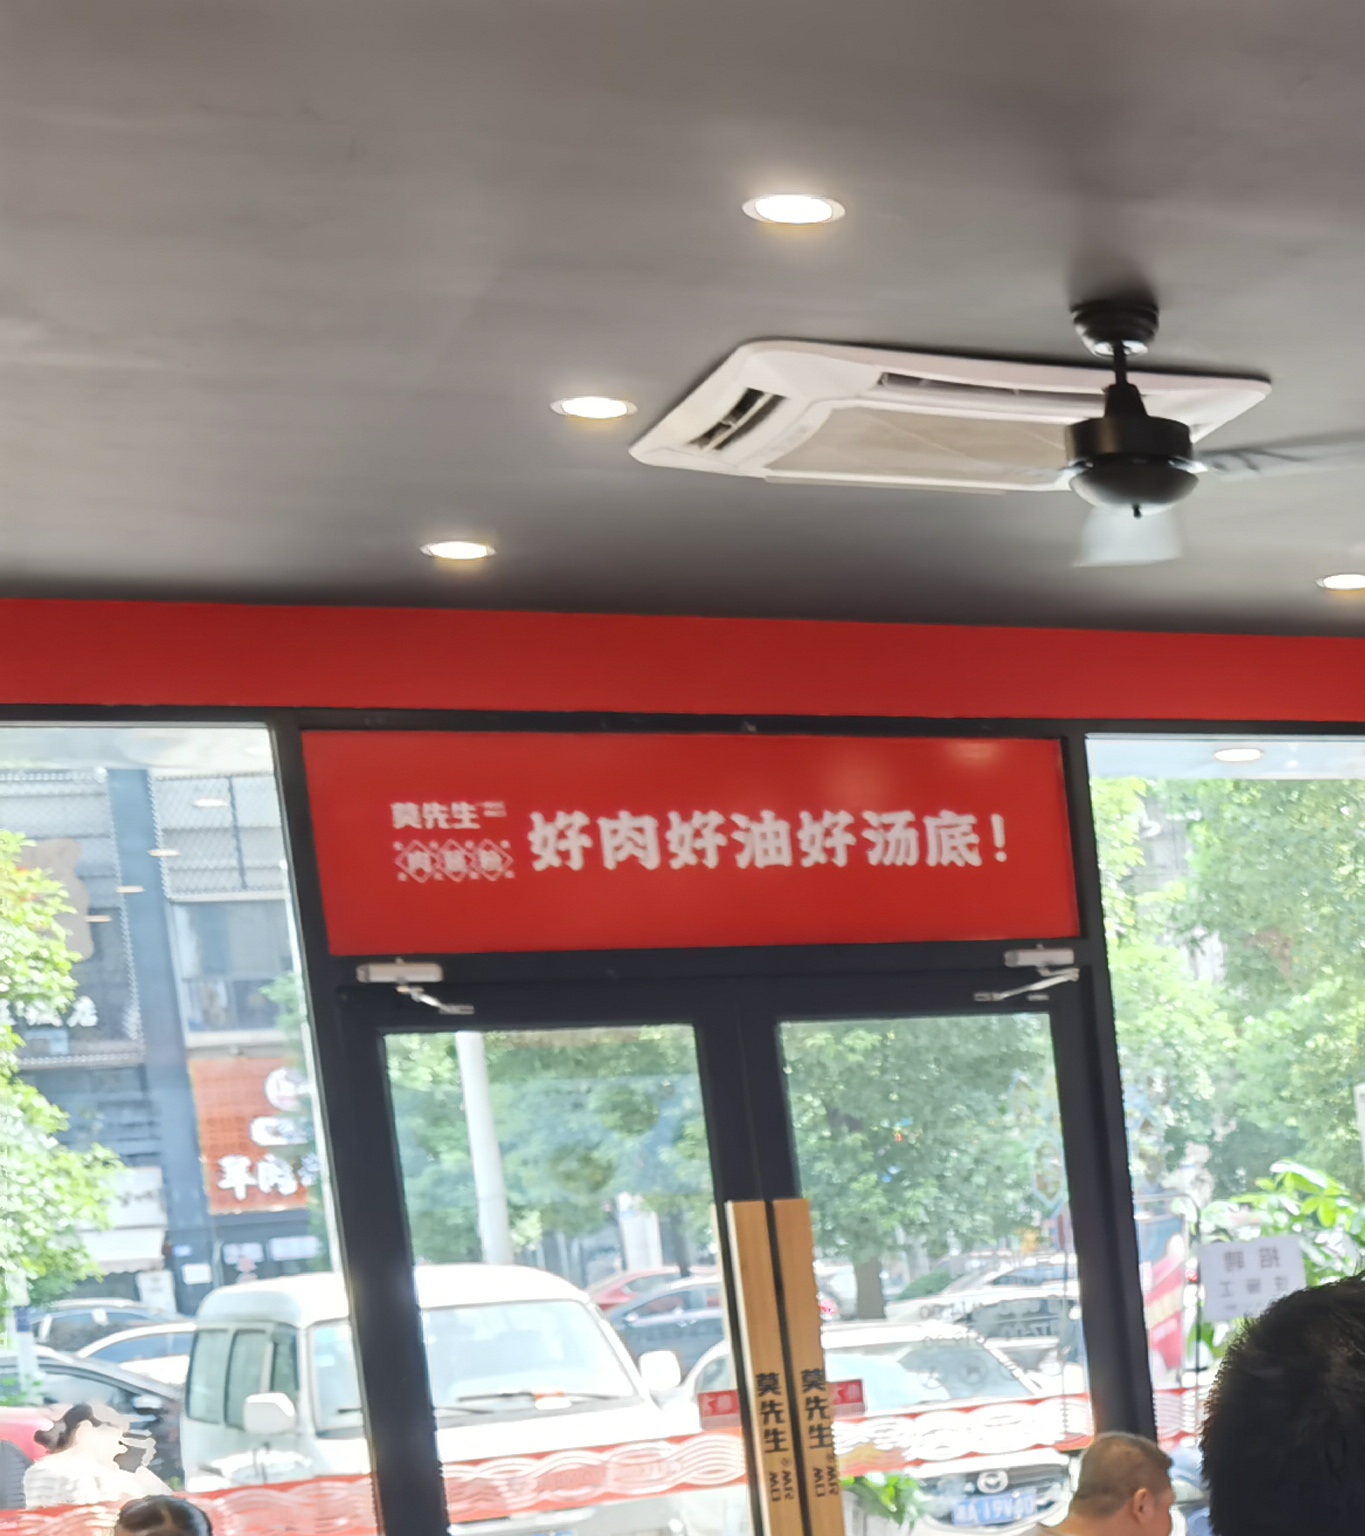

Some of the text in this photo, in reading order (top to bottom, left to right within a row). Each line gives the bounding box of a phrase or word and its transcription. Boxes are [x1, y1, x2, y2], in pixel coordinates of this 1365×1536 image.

[527, 808, 1008, 871] 好肉好油好汤底!
[756, 1373, 789, 1453] 莫先生
